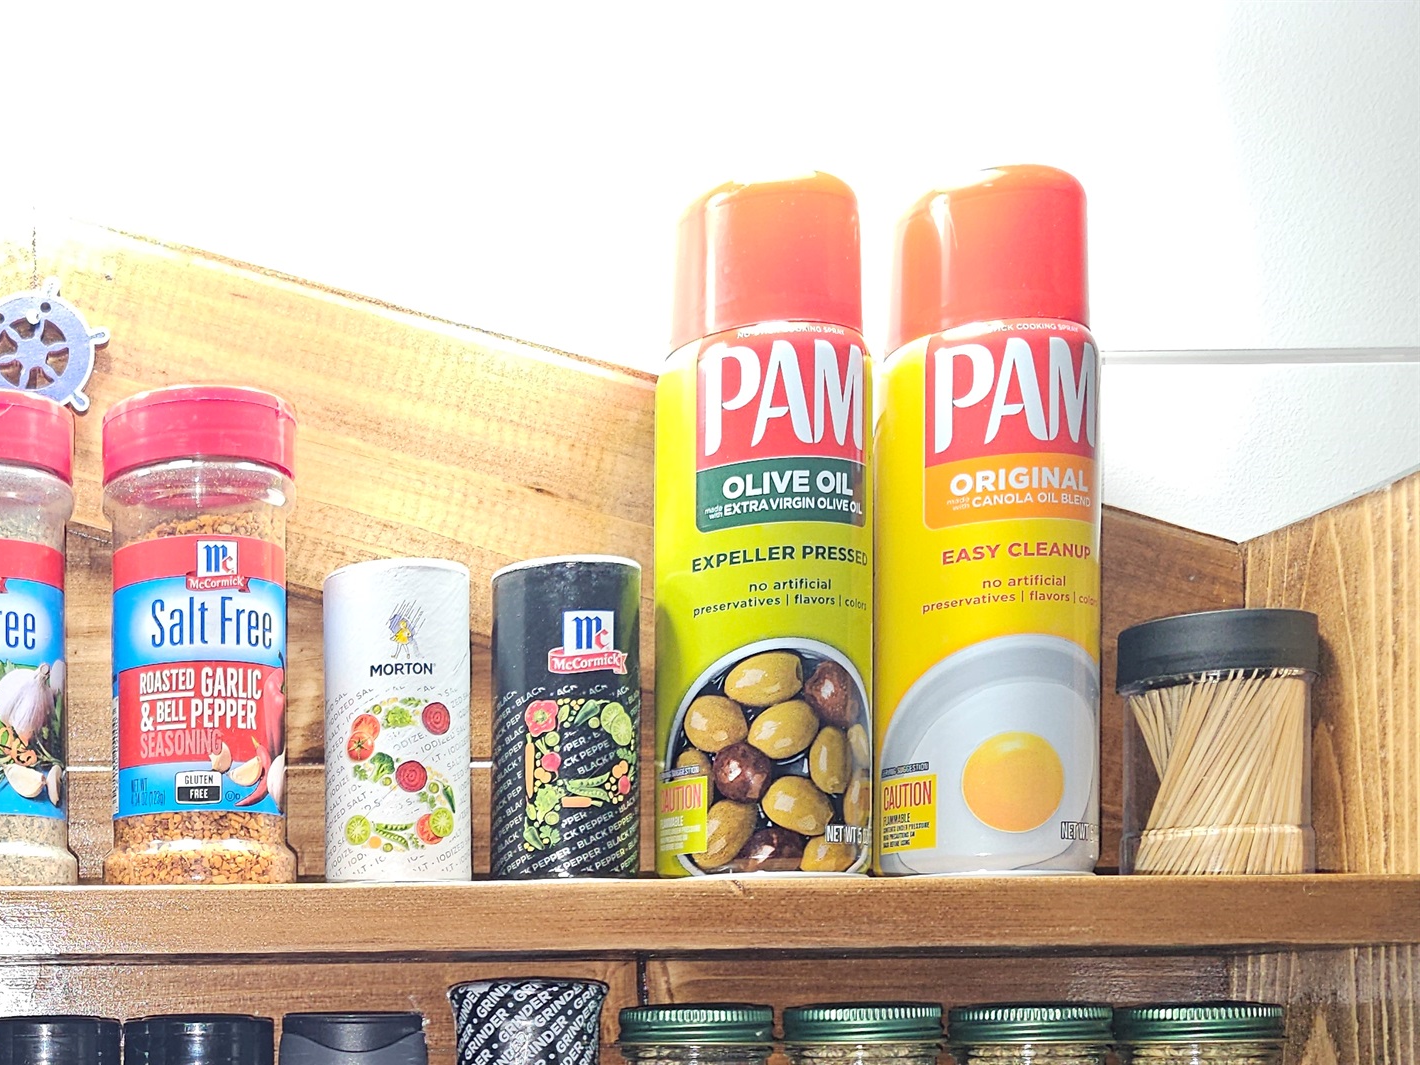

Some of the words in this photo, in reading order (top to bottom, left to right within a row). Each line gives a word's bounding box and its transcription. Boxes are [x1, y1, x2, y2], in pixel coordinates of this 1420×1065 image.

[703, 339, 863, 456] PAM
[935, 337, 1095, 454] PAM
[722, 470, 810, 499] OLIVE
[816, 471, 853, 496] OIL
[950, 466, 1088, 497] ORIGINAL
[724, 501, 768, 516] EXTRA
[770, 497, 815, 511] VIRGIN
[817, 498, 848, 512] OLIVE
[850, 501, 862, 515] OIL
[972, 493, 1031, 508] CANOLA
[1038, 493, 1058, 504] OIL
[1061, 494, 1090, 507] BLEND
[692, 545, 795, 573] EXPELLER
[802, 546, 868, 566] PRESSED
[942, 544, 1000, 565] EASY
[1007, 542, 1090, 560] CLEANUP
[189, 578, 244, 590] McCormick
[749, 581, 767, 592] no
[773, 579, 831, 590] artificial
[693, 596, 780, 617] preservatives
[794, 595, 835, 605] flavors
[845, 598, 866, 611] colors
[152, 597, 208, 648] Salt
[221, 597, 271, 649] Free
[370, 663, 433, 677] MORTON
[553, 654, 620, 670] McCormick
[140, 668, 194, 693] ROASTED
[201, 667, 262, 699] GARLIC
[140, 708, 154, 731] &
[157, 703, 186, 722] BELL
[191, 699, 256, 730] PEPPER
[140, 729, 222, 759] SEASONING
[884, 780, 931, 811] CAUTION
